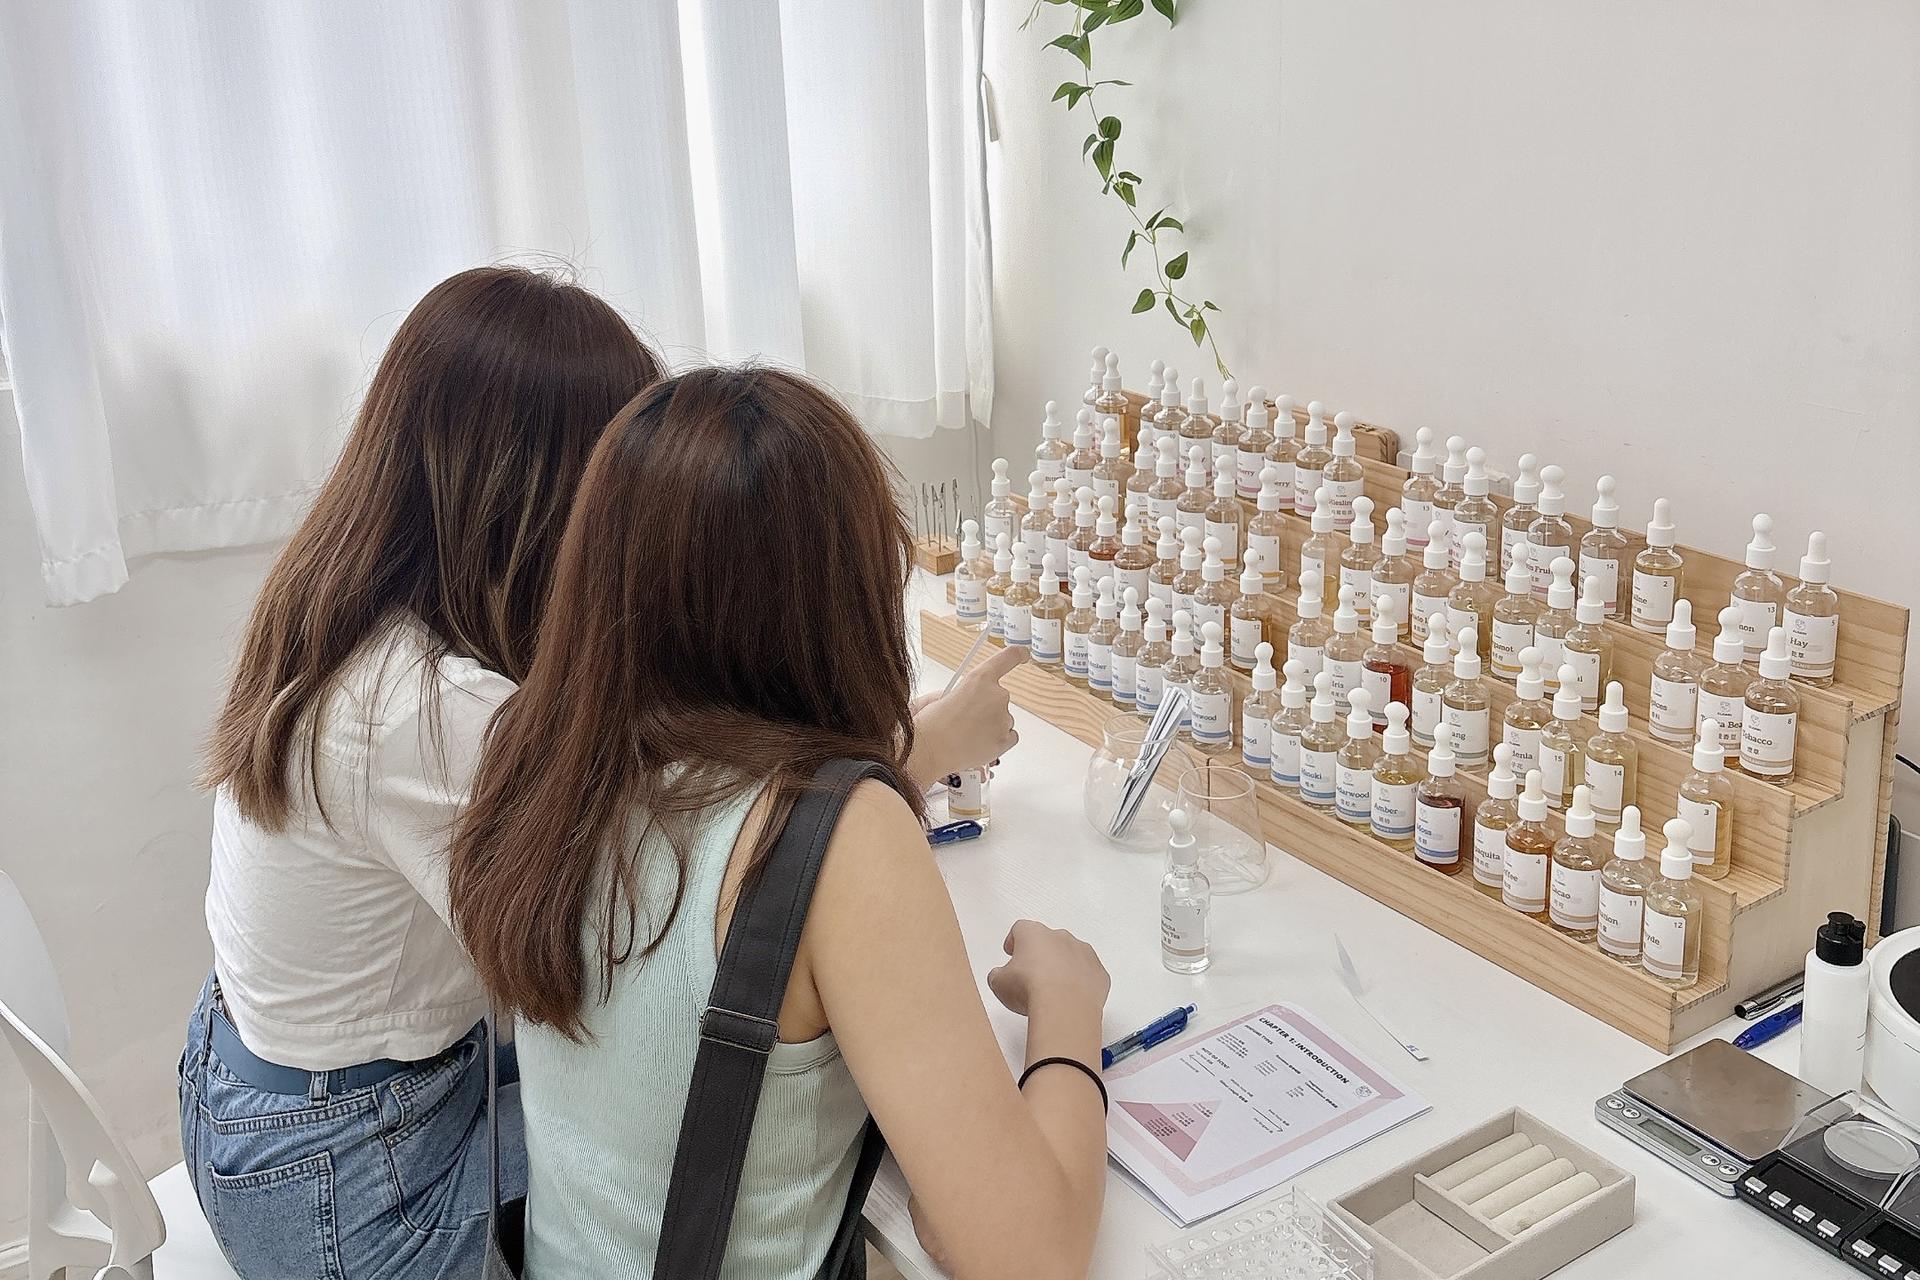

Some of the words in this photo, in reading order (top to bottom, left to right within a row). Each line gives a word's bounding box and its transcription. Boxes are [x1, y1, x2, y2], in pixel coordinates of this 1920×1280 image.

[1535, 566, 1554, 575] Frui
[1790, 636, 1808, 648] Hay
[1374, 802, 1399, 815] Amber
[1258, 1016, 1289, 1038] CHAPTER
[1294, 1042, 1350, 1083] INTRODUCTION
